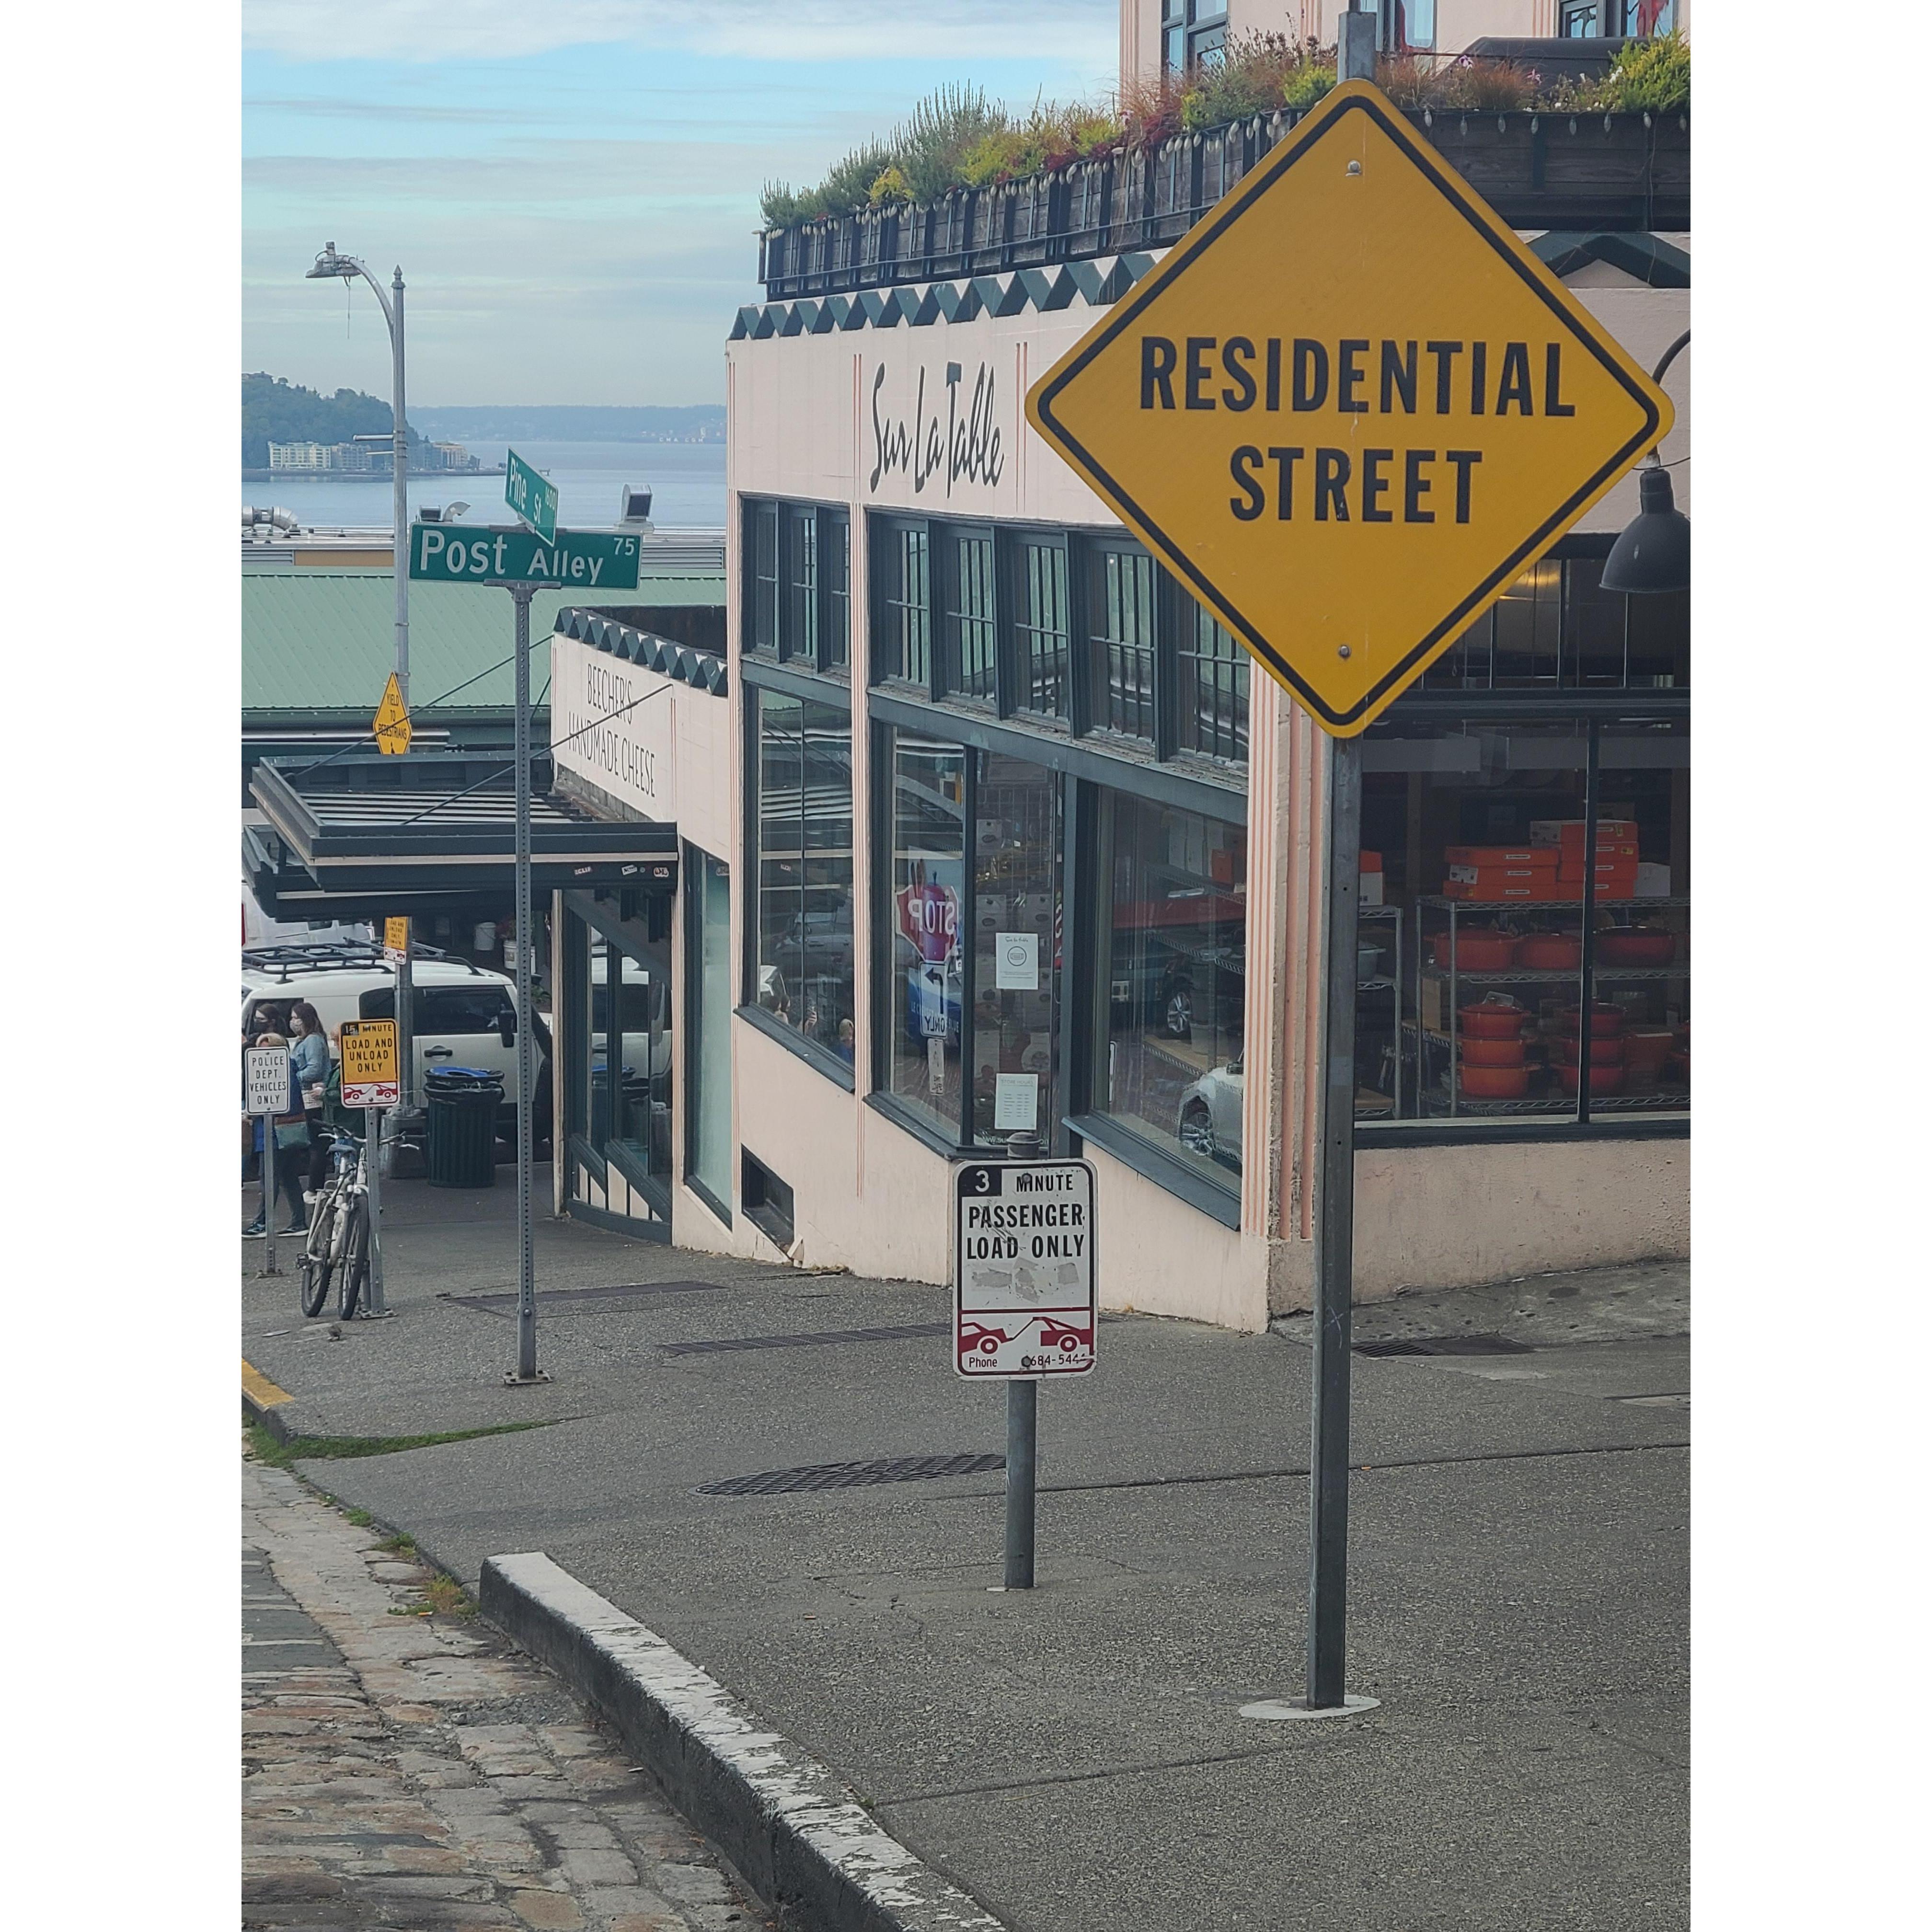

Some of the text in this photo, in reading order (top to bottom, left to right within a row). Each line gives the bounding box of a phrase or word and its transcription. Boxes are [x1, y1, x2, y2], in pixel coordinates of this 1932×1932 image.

[1140, 336, 1576, 417] RESIDENTIAL
[870, 360, 1004, 499] Sur La Table
[509, 457, 541, 525] Pine St
[1230, 445, 1482, 524] STREET
[544, 486, 556, 511] 1600
[613, 537, 635, 556] 75
[420, 529, 603, 585] Post Alley
[387, 693, 399, 706] YIELD
[587, 663, 632, 725] BEECHER'S
[390, 709, 396, 722] TO
[378, 723, 407, 740] PEDESTRIANS
[568, 711, 656, 798] HANDMADE CHEESE
[363, 1024, 392, 1033] MINUTE
[346, 1038, 392, 1049] LOAD AND
[252, 1056, 284, 1067] POLICE
[349, 1050, 389, 1061] UNLOAD
[256, 1069, 281, 1079] DEPT.
[357, 1062, 383, 1073] ONLY
[250, 1081, 286, 1092] VEHICLES
[257, 1094, 280, 1104] ONLY
[975, 1170, 1073, 1192] 3 MINUTE
[968, 1203, 1083, 1229] PASSENGER
[966, 1234, 1084, 1260] LOAD ONLY
[968, 1353, 1086, 1368] Phone 684-544
